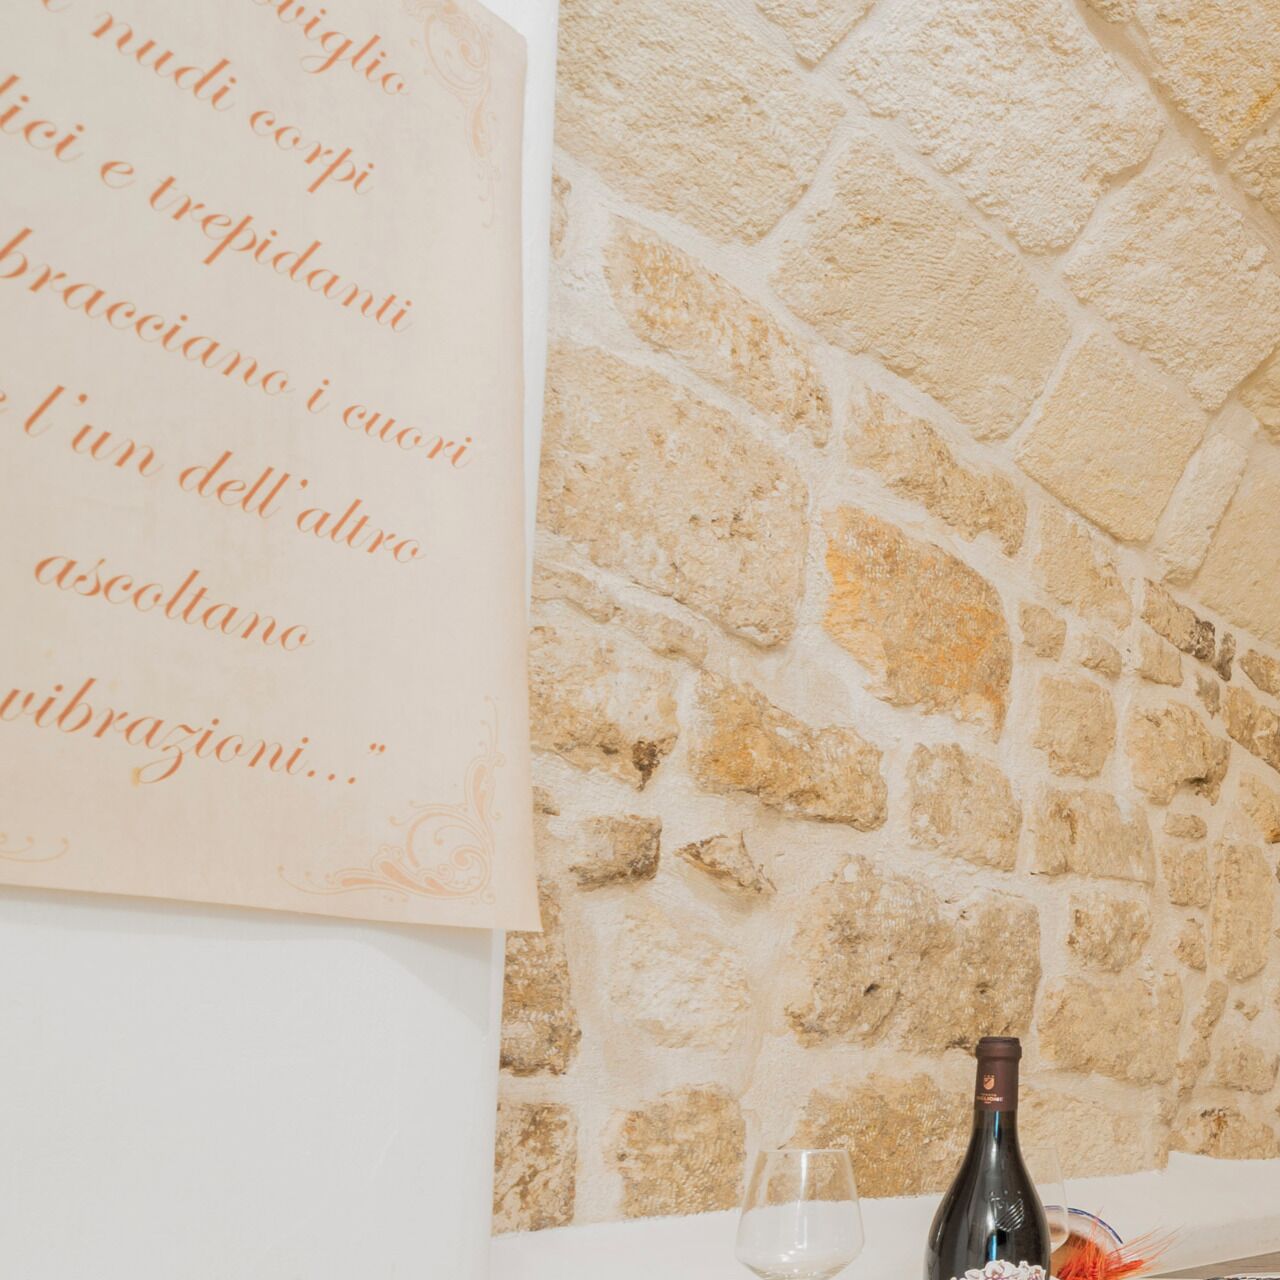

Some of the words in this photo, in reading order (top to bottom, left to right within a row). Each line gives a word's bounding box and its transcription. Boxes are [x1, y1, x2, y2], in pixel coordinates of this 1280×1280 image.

[252, 0, 408, 96] viglio
[91, 11, 237, 112] nudi
[248, 109, 376, 195] corpi
[99, 160, 136, 190] e
[148, 175, 413, 333] trepidanti
[23, 384, 162, 478] l'un
[305, 378, 331, 415] i
[341, 404, 473, 469] cuori
[33, 555, 313, 653] ascoltano
